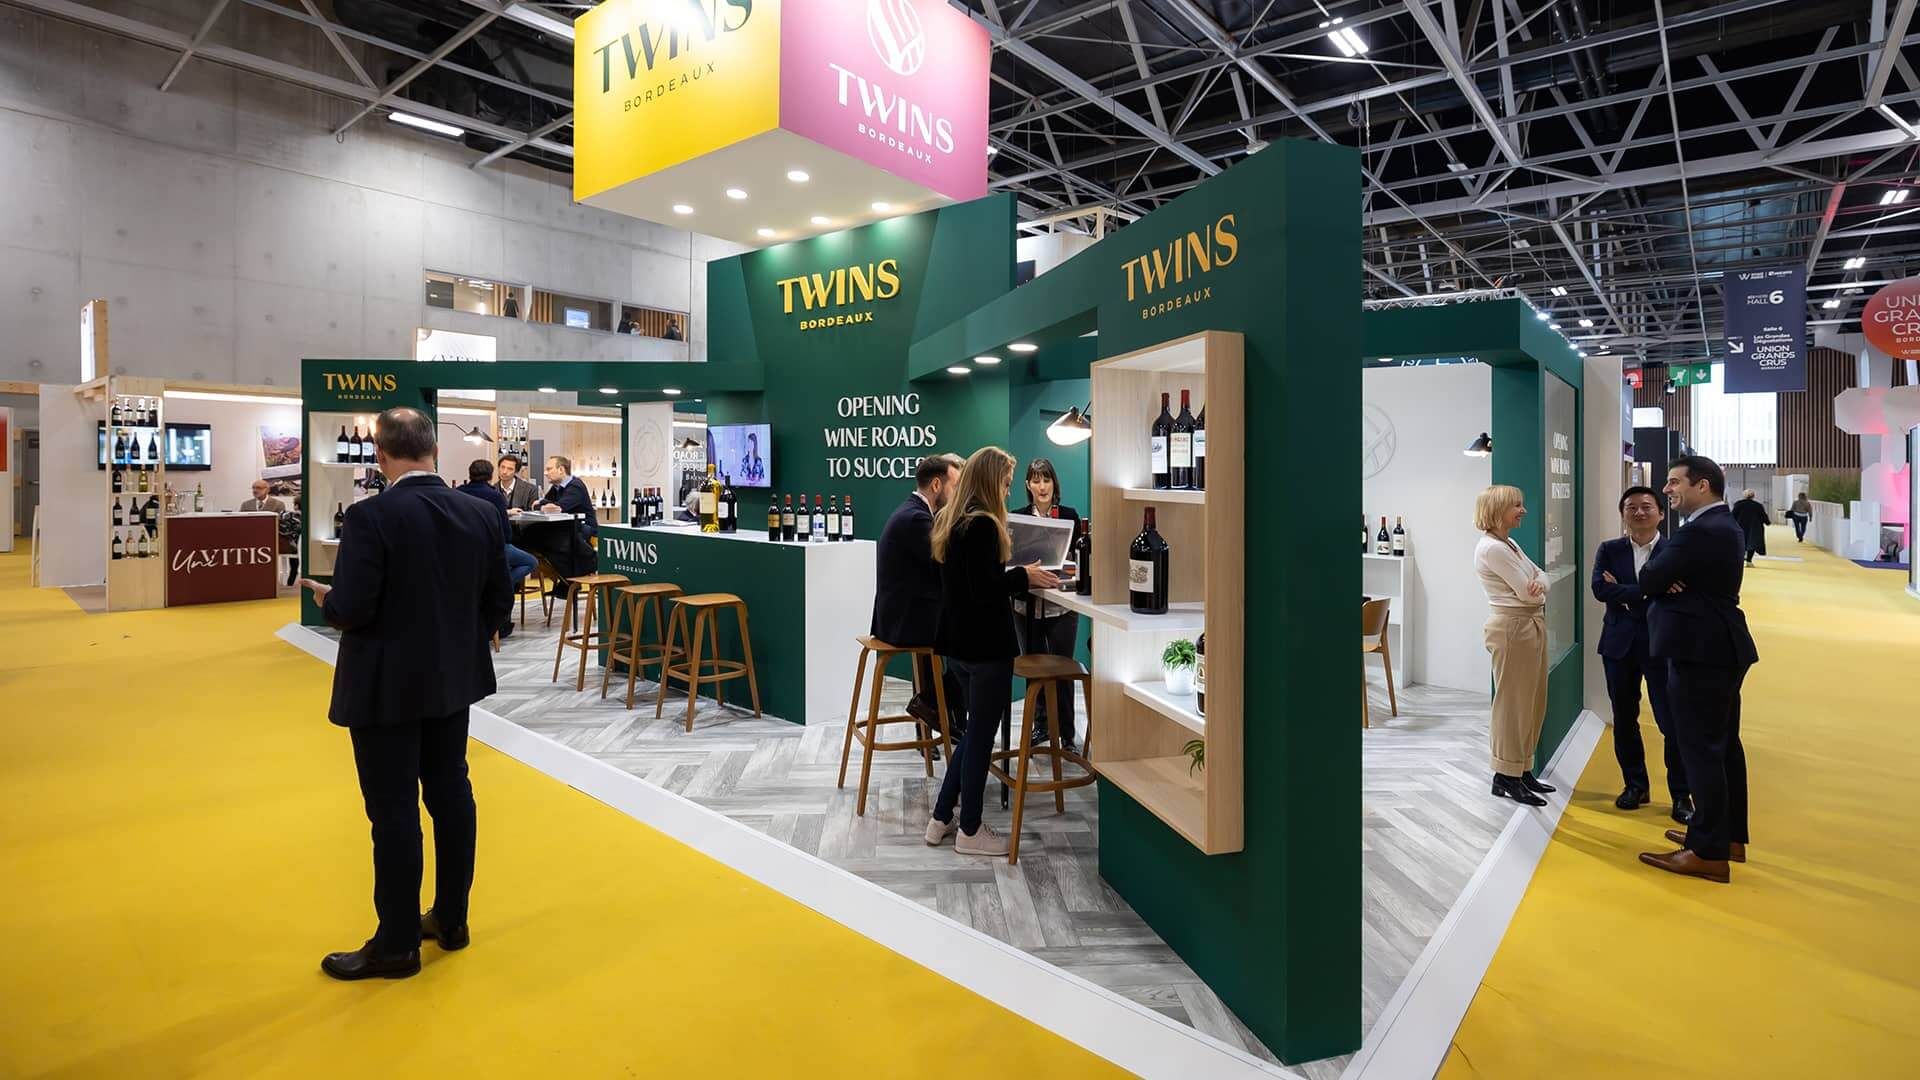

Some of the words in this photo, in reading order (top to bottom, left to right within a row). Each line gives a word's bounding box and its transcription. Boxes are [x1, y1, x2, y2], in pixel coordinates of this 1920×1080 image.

[624, 61, 716, 112] BORDEAUX
[829, 62, 954, 154] TWINS
[858, 122, 933, 164] BORDEAUX
[1120, 213, 1239, 302] TWINS
[776, 258, 901, 314] TWINS
[1769, 290, 1784, 305] 6
[1142, 287, 1212, 320] BORDEAUX
[800, 311, 873, 330] BORDEAUX
[1751, 351, 1796, 360] GRANDS
[1756, 344, 1790, 353] UNION
[1759, 359, 1787, 367] CRUS
[322, 373, 397, 392] TWINS
[837, 393, 920, 418] OPENING
[824, 426, 868, 448] WINE
[871, 424, 937, 448] ROADS
[826, 457, 851, 478] TO
[854, 456, 926, 479] SUCCE
[603, 537, 658, 565] TWINS
[614, 563, 647, 574] BORDEAUX
